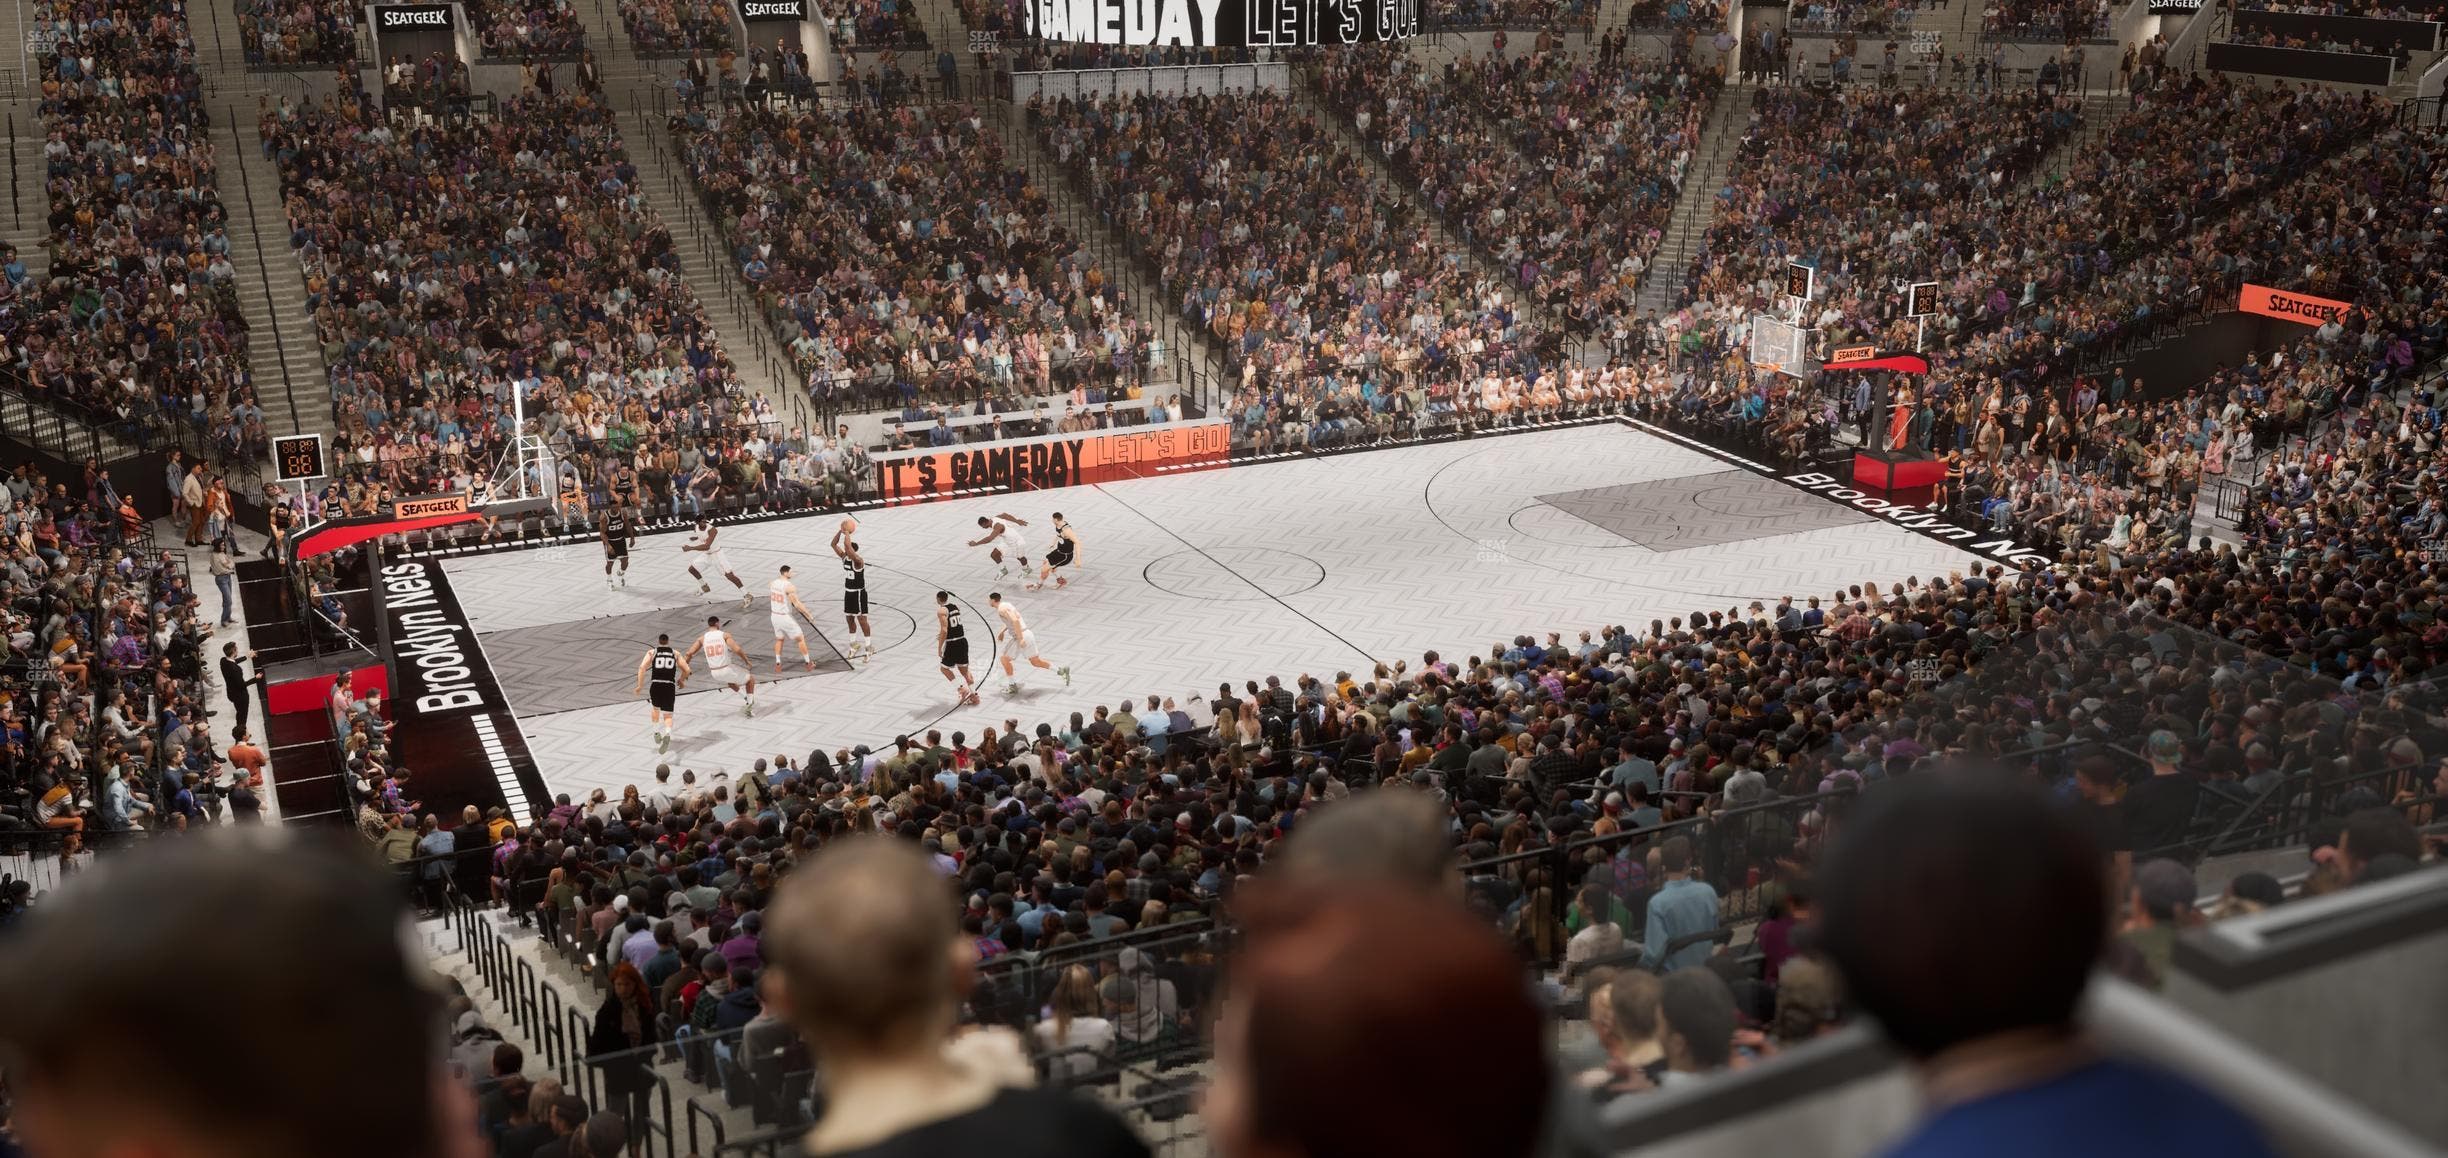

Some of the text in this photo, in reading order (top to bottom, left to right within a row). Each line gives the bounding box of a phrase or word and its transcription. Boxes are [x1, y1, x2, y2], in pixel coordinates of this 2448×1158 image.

[384, 9, 447, 26] SEATGEEK
[745, 1, 801, 16] SEATGEEK
[1039, 0, 1219, 46] GAMEDAY
[1377, 0, 1417, 41] GO!
[876, 422, 1232, 490] IT'S GAMEDAY LET'S GO!
[402, 499, 459, 516] SEATGEEK
[634, 505, 829, 534] BrookynNets.com
[1782, 472, 2052, 567] Brooklyn Ne
[381, 562, 484, 713] Brooklyn Nets
[655, 656, 675, 669] 00
